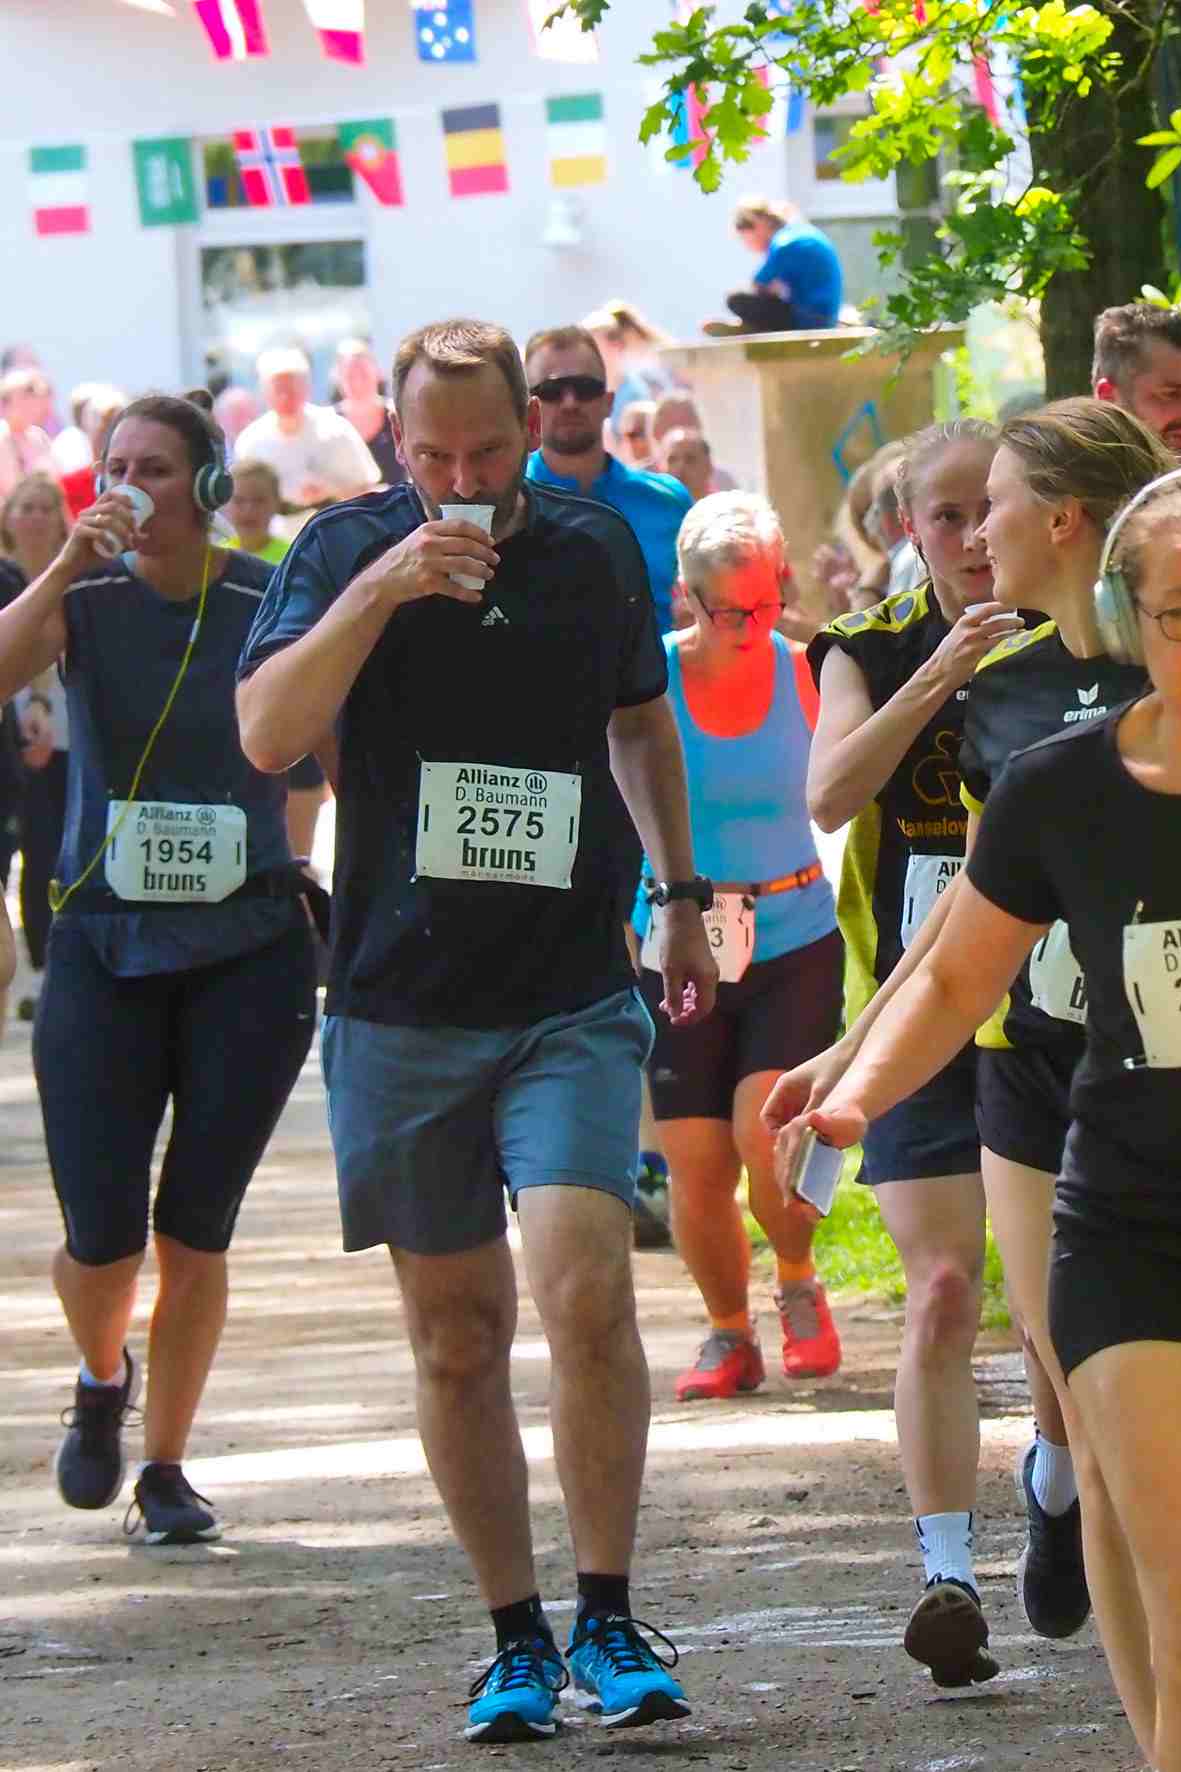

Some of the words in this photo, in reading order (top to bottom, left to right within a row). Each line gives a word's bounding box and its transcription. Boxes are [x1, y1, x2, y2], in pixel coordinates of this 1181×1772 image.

[1063, 706, 1107, 722] erima
[456, 768, 520, 788] Allianz
[455, 786, 471, 802] D.
[475, 787, 548, 809] Baumann
[137, 805, 193, 822] Allianz
[457, 805, 545, 840] 2575
[140, 839, 213, 865] 1954
[462, 838, 536, 871] bruns
[144, 866, 207, 892] bruns
